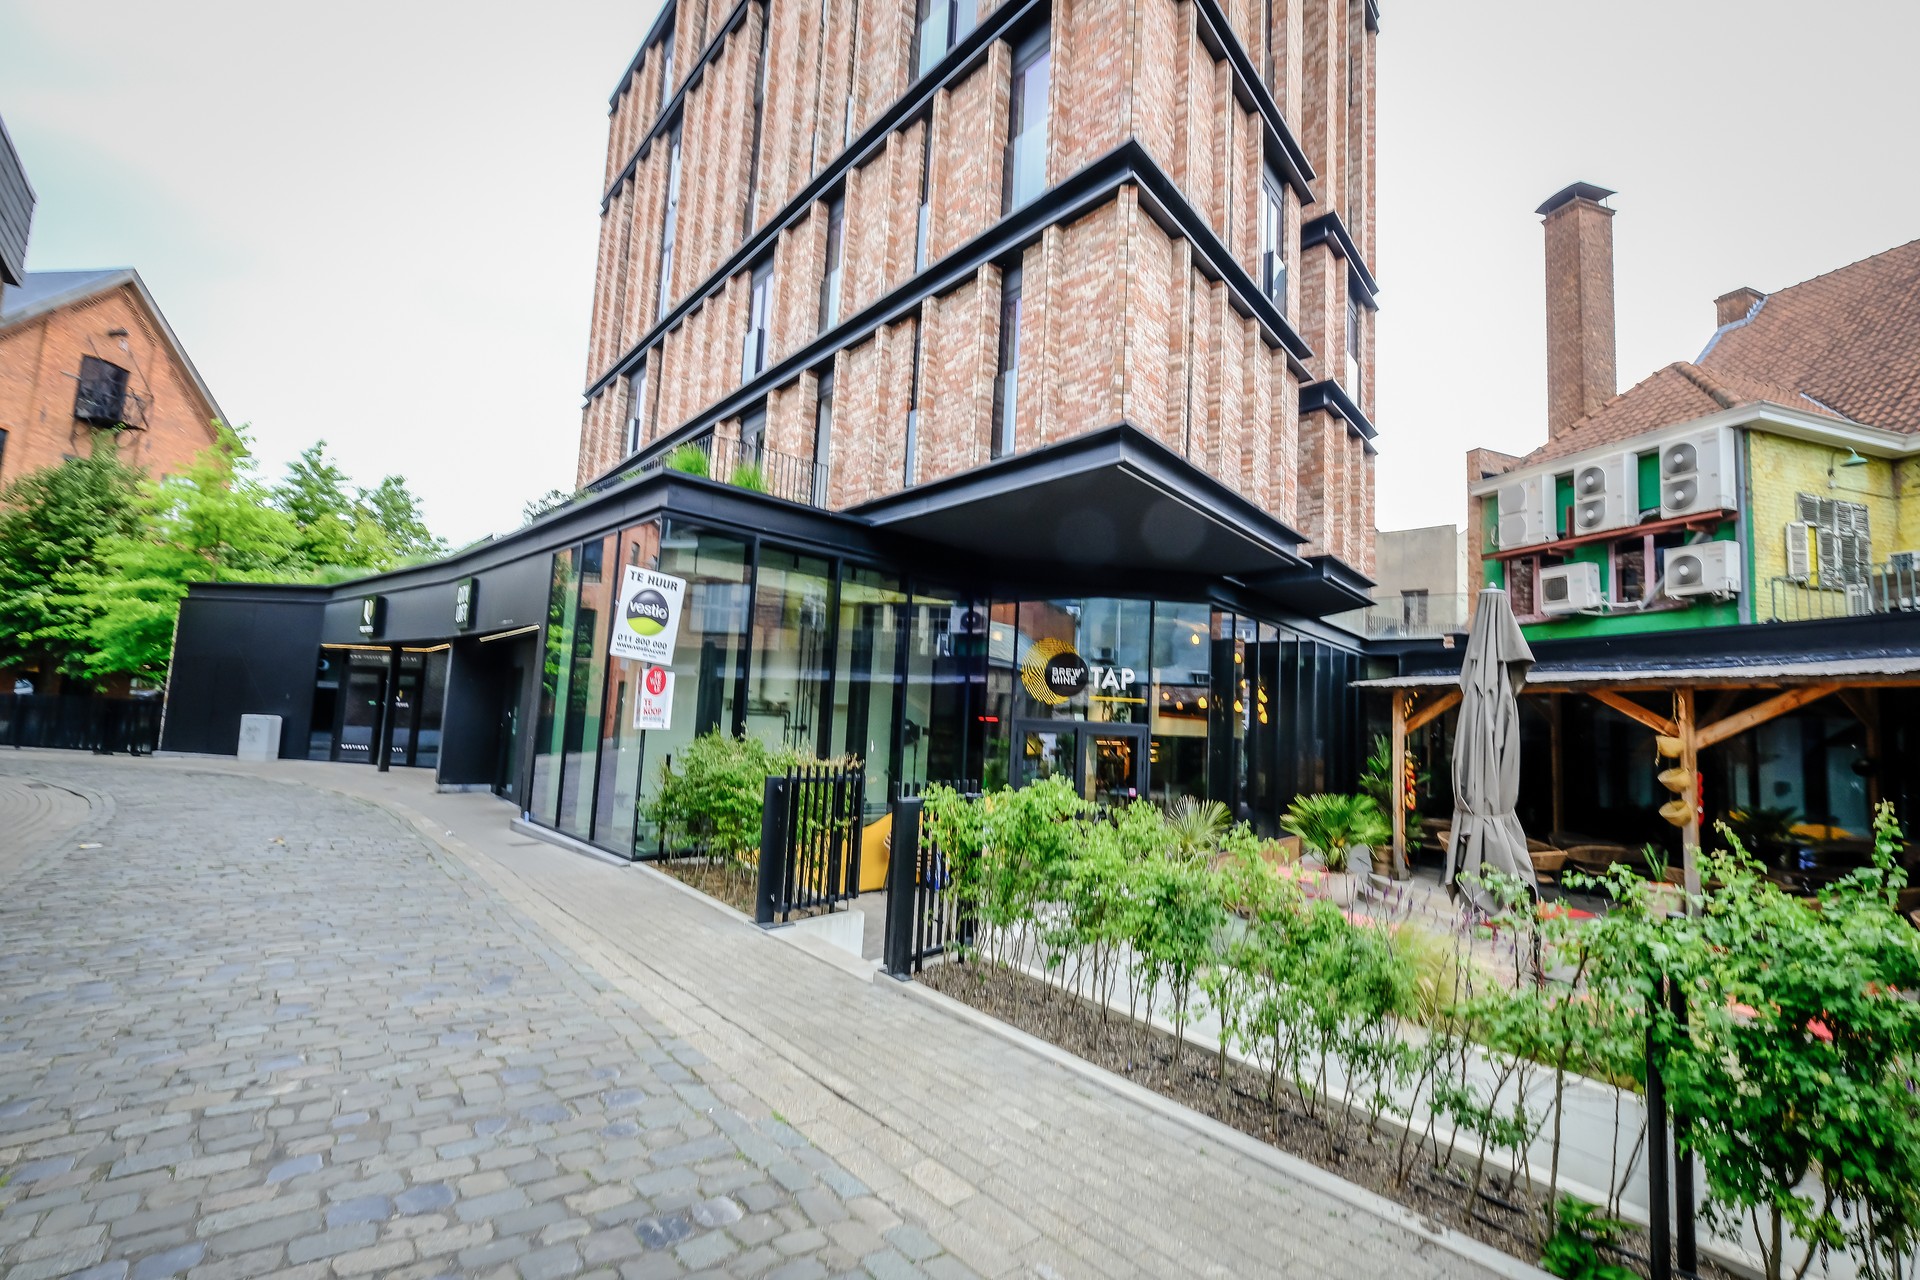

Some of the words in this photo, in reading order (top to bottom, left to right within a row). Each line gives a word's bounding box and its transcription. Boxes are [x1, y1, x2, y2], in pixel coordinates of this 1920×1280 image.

[630, 570, 644, 583] TE
[648, 575, 678, 591] HUUR
[629, 600, 668, 620] vestio
[617, 633, 632, 643] 011
[635, 637, 650, 646] 800
[652, 640, 667, 650] 000
[1051, 667, 1081, 679] BREW
[1051, 675, 1077, 686] MINE
[1090, 666, 1135, 691] TAP
[643, 707, 662, 716] KOOP
